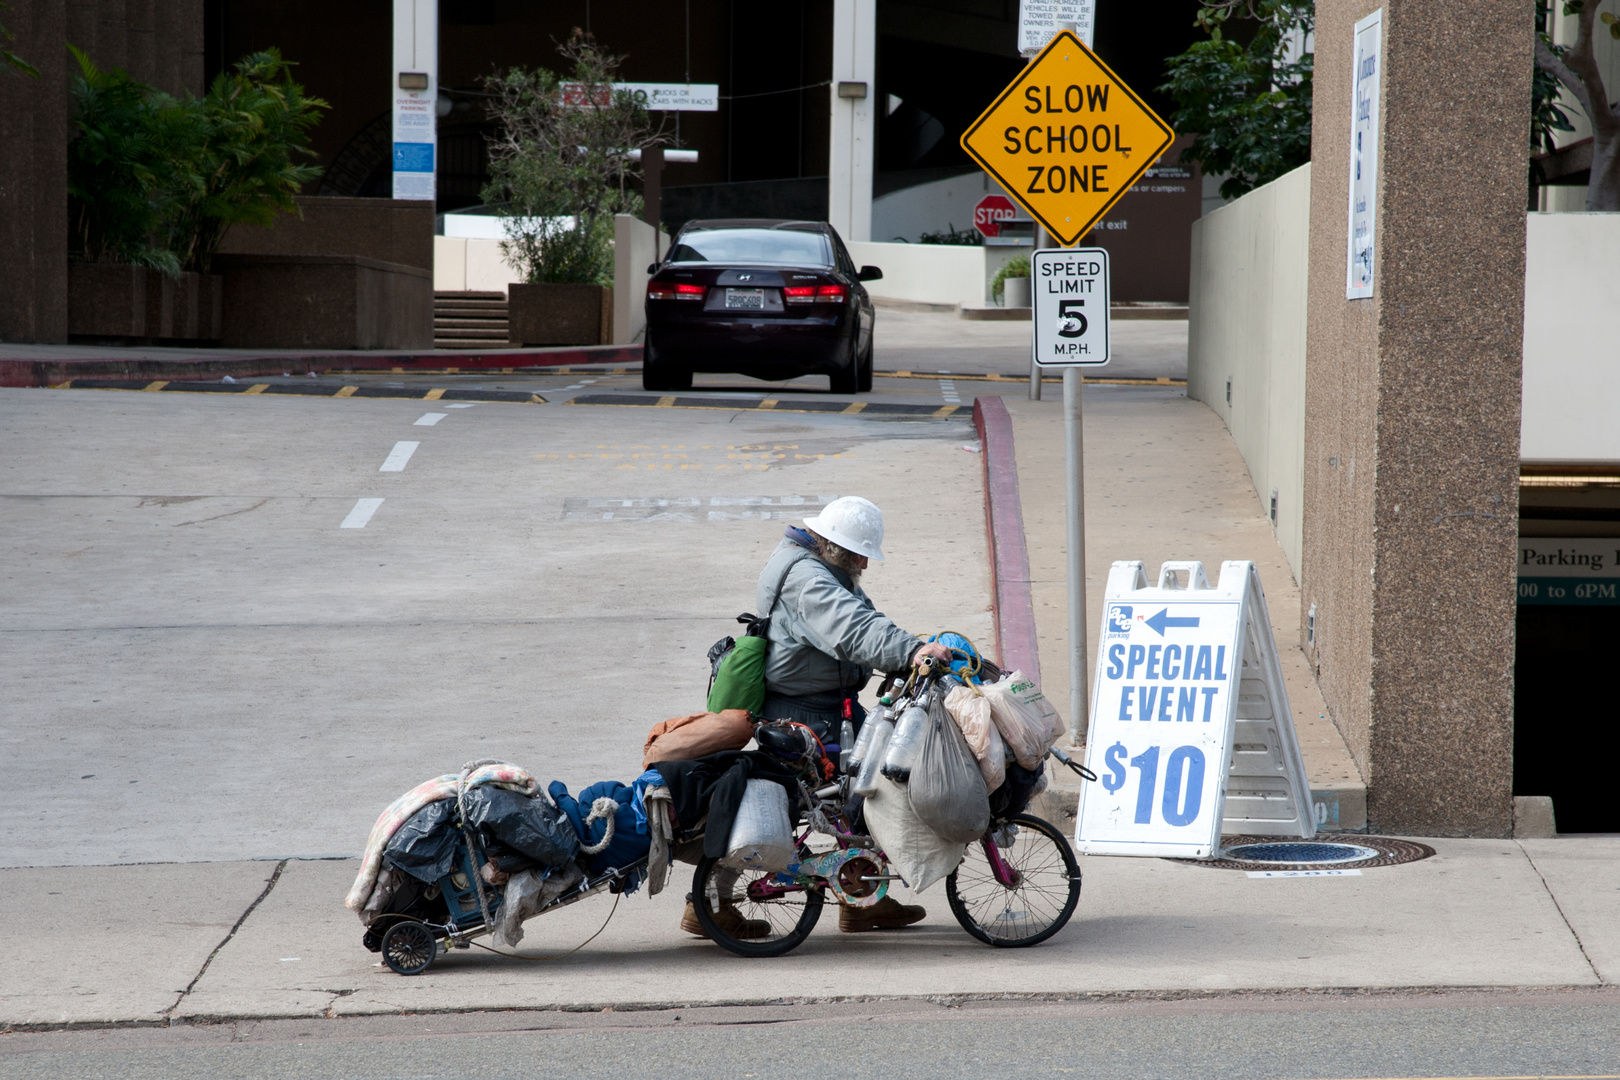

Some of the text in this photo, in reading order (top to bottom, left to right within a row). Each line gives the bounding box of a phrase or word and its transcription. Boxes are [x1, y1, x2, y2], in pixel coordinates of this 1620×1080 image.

[1028, 12, 1053, 20] TOWED
[653, 89, 677, 97] TRUCKS
[1024, 84, 1110, 114] SLOW
[691, 98, 713, 106] RACKS
[1003, 124, 1132, 154] SCHOOL
[1027, 165, 1110, 194] ZONE
[976, 208, 1014, 224] STOP
[1106, 220, 1128, 230] exit
[1041, 262, 1101, 277] SPEED
[1048, 279, 1095, 294] LIMIT
[1058, 299, 1088, 338] 5
[1054, 343, 1092, 355] M.P.H.
[1521, 548, 1604, 571] Parking
[1547, 584, 1566, 599] to
[1574, 583, 1617, 599] 6PM
[1109, 607, 1132, 631] ace
[1107, 632, 1131, 640] parking
[1106, 643, 1227, 681] SPECIAL
[1118, 686, 1219, 723] EVENT
[1102, 740, 1206, 827] $10
